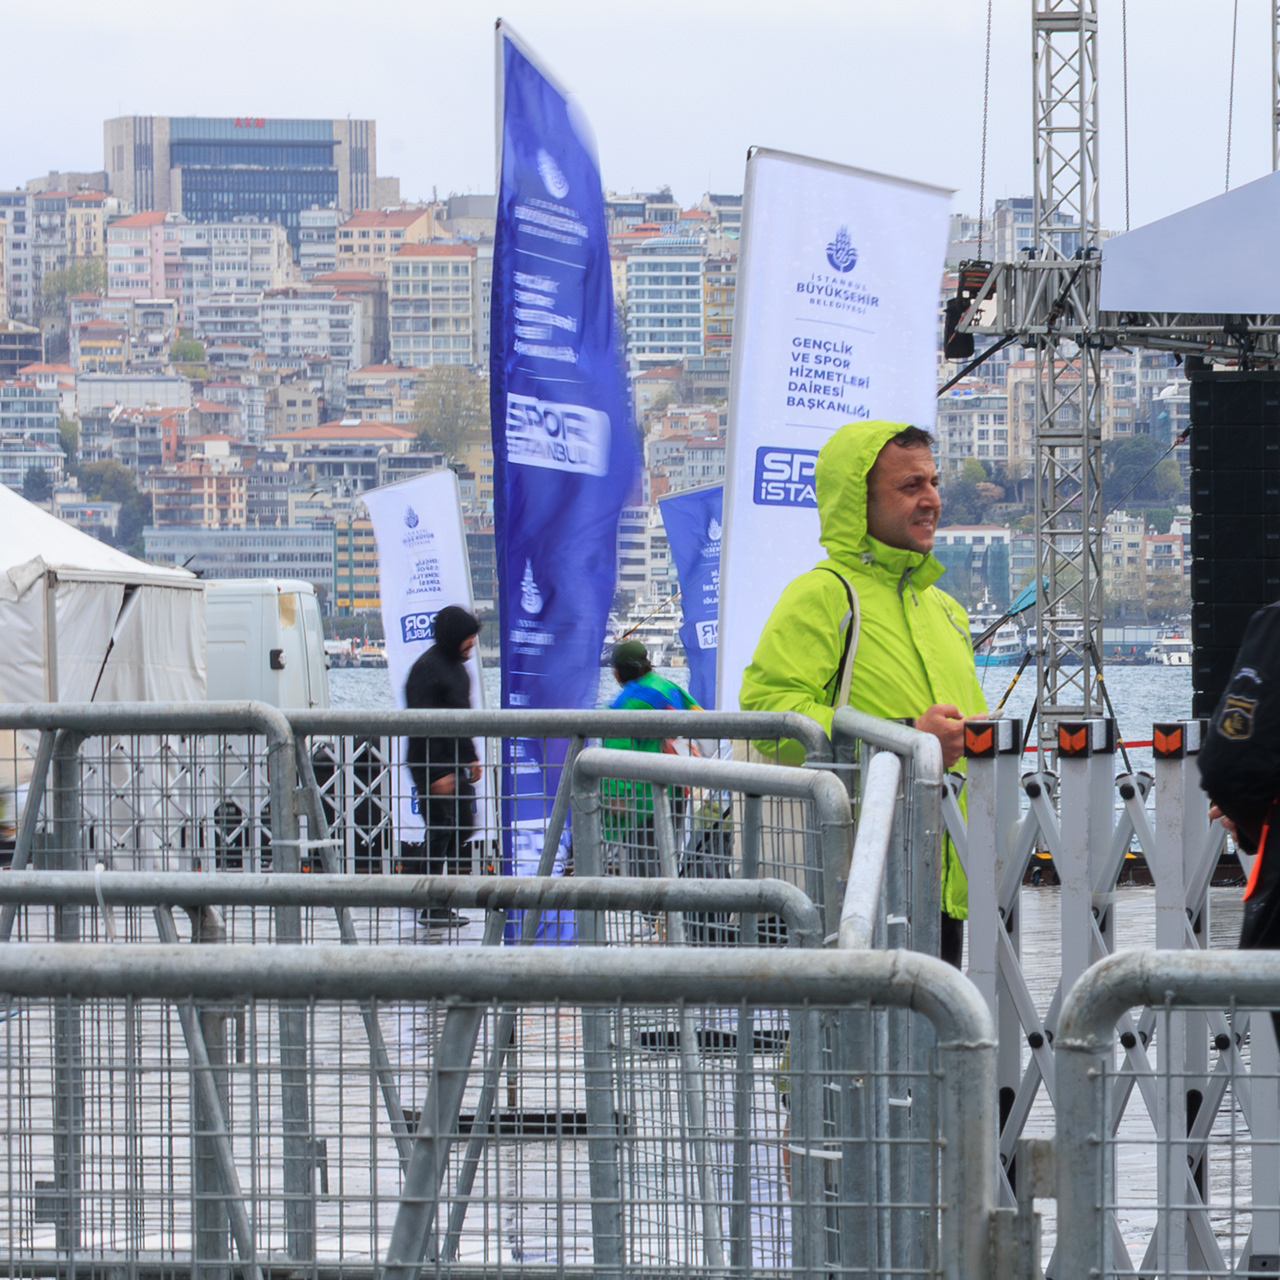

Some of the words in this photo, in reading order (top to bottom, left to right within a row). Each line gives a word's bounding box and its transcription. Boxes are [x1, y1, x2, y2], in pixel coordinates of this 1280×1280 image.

[233, 116, 265, 129] AKM
[792, 337, 853, 356] GENÇLİK
[791, 352, 810, 363] VE
[814, 354, 851, 370] SPOR
[789, 364, 870, 390] HİZMETLERİ
[788, 380, 844, 398] DAİRESİ
[786, 396, 870, 419] BAŞKANLIĞI
[763, 452, 818, 482] SP
[761, 482, 818, 502] iSTA
